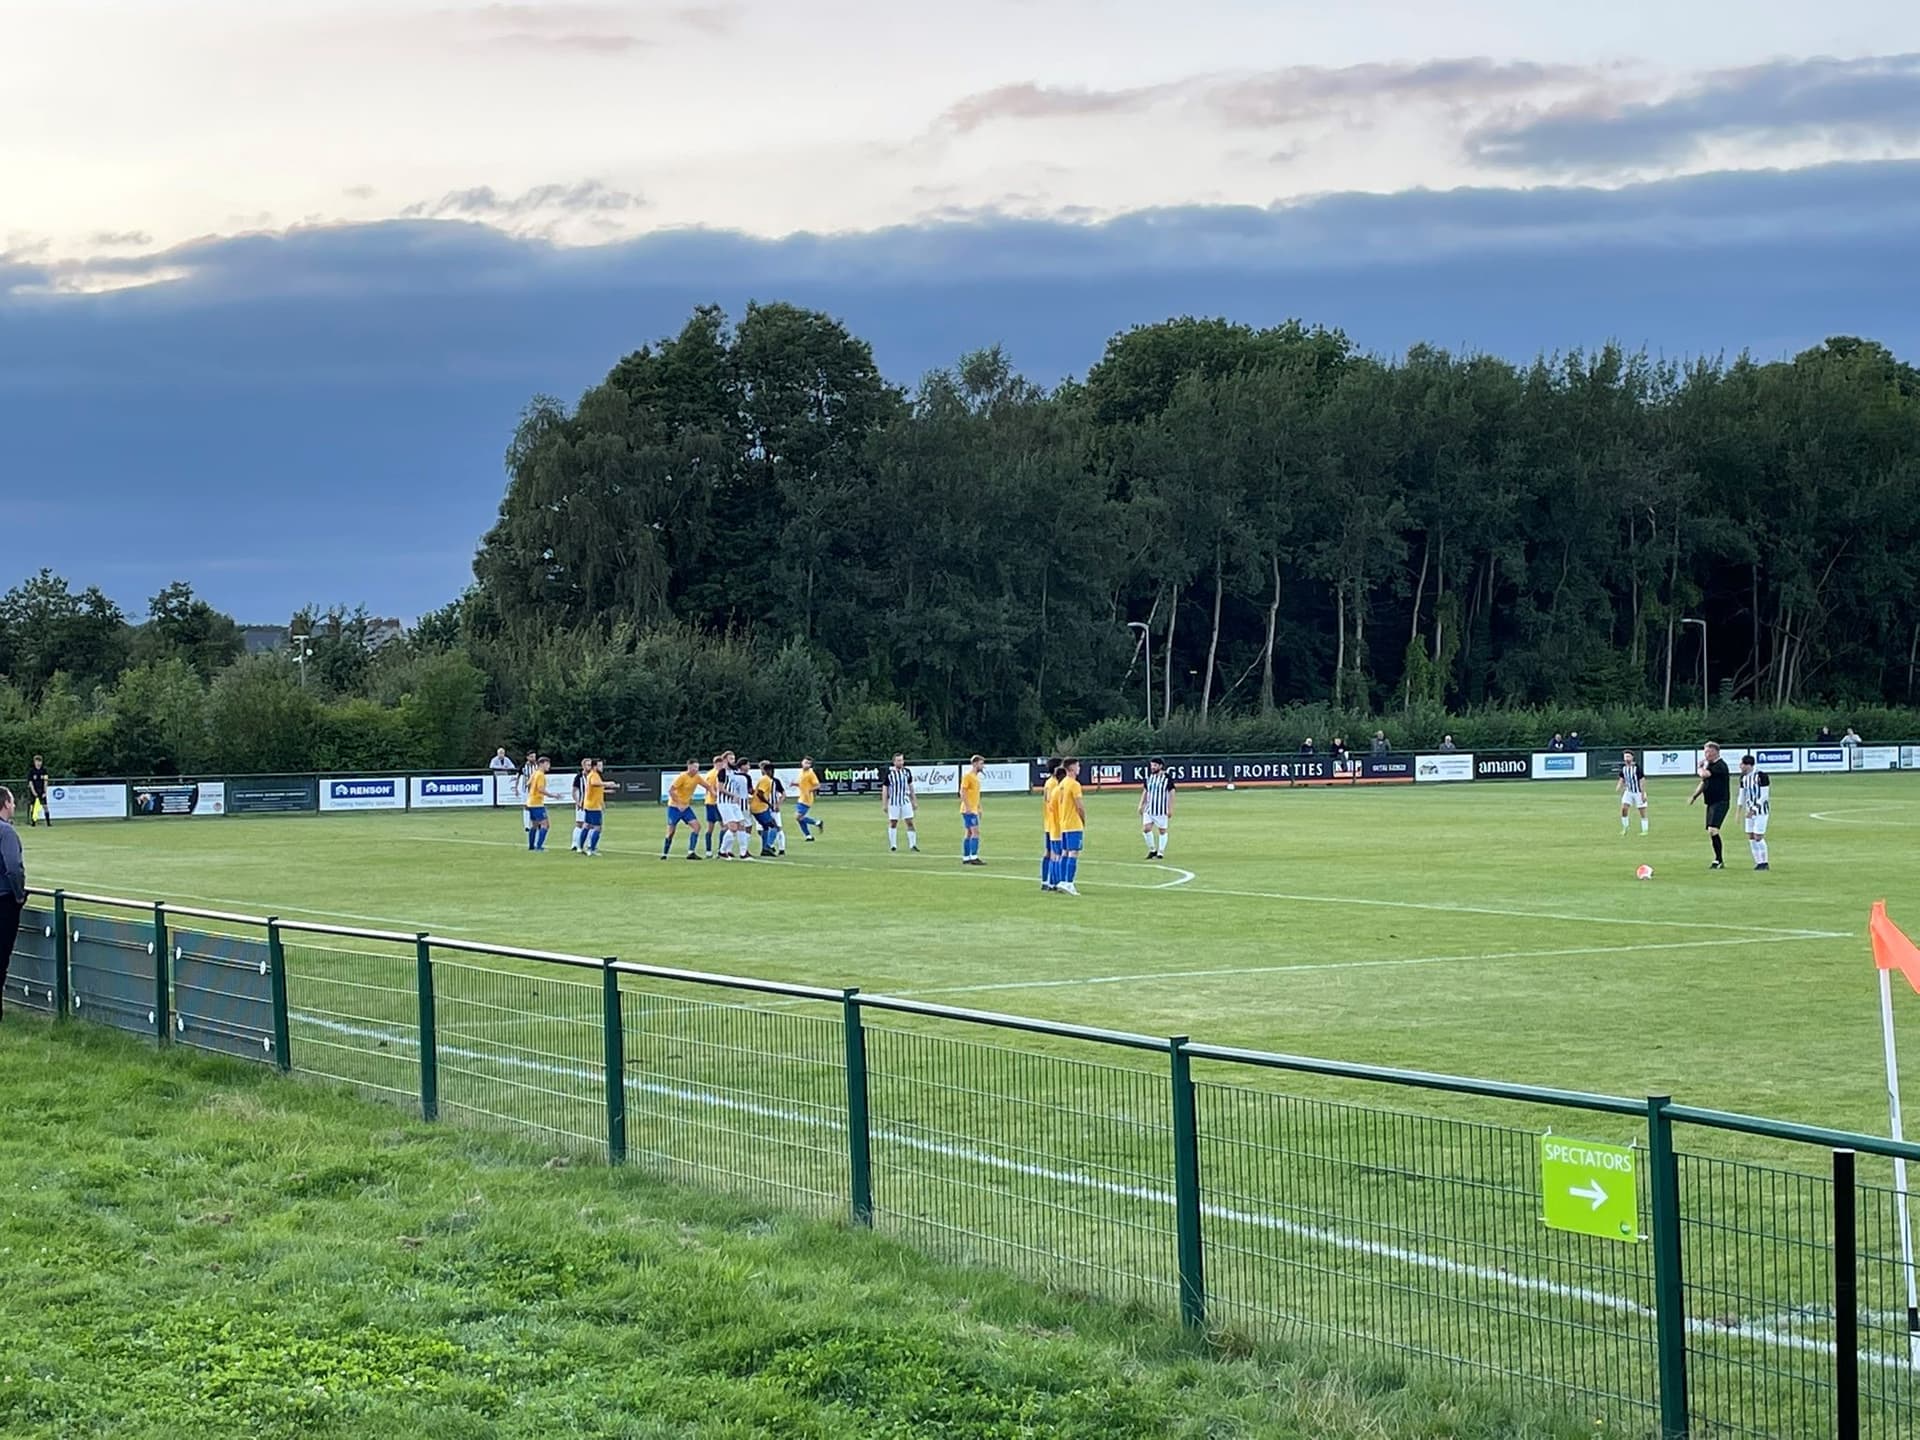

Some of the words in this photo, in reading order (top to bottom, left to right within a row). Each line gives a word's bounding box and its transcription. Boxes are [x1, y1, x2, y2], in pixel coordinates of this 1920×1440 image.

[1134, 766, 1185, 779] KIGS
[1191, 765, 1225, 778] HILL
[1234, 763, 1323, 777] PROPERTIES
[1478, 760, 1527, 773] amano
[824, 767, 879, 782] twistprint
[349, 786, 390, 795] RENSON
[439, 783, 479, 792] RENSON
[1545, 1143, 1632, 1172] SPECTATORS
